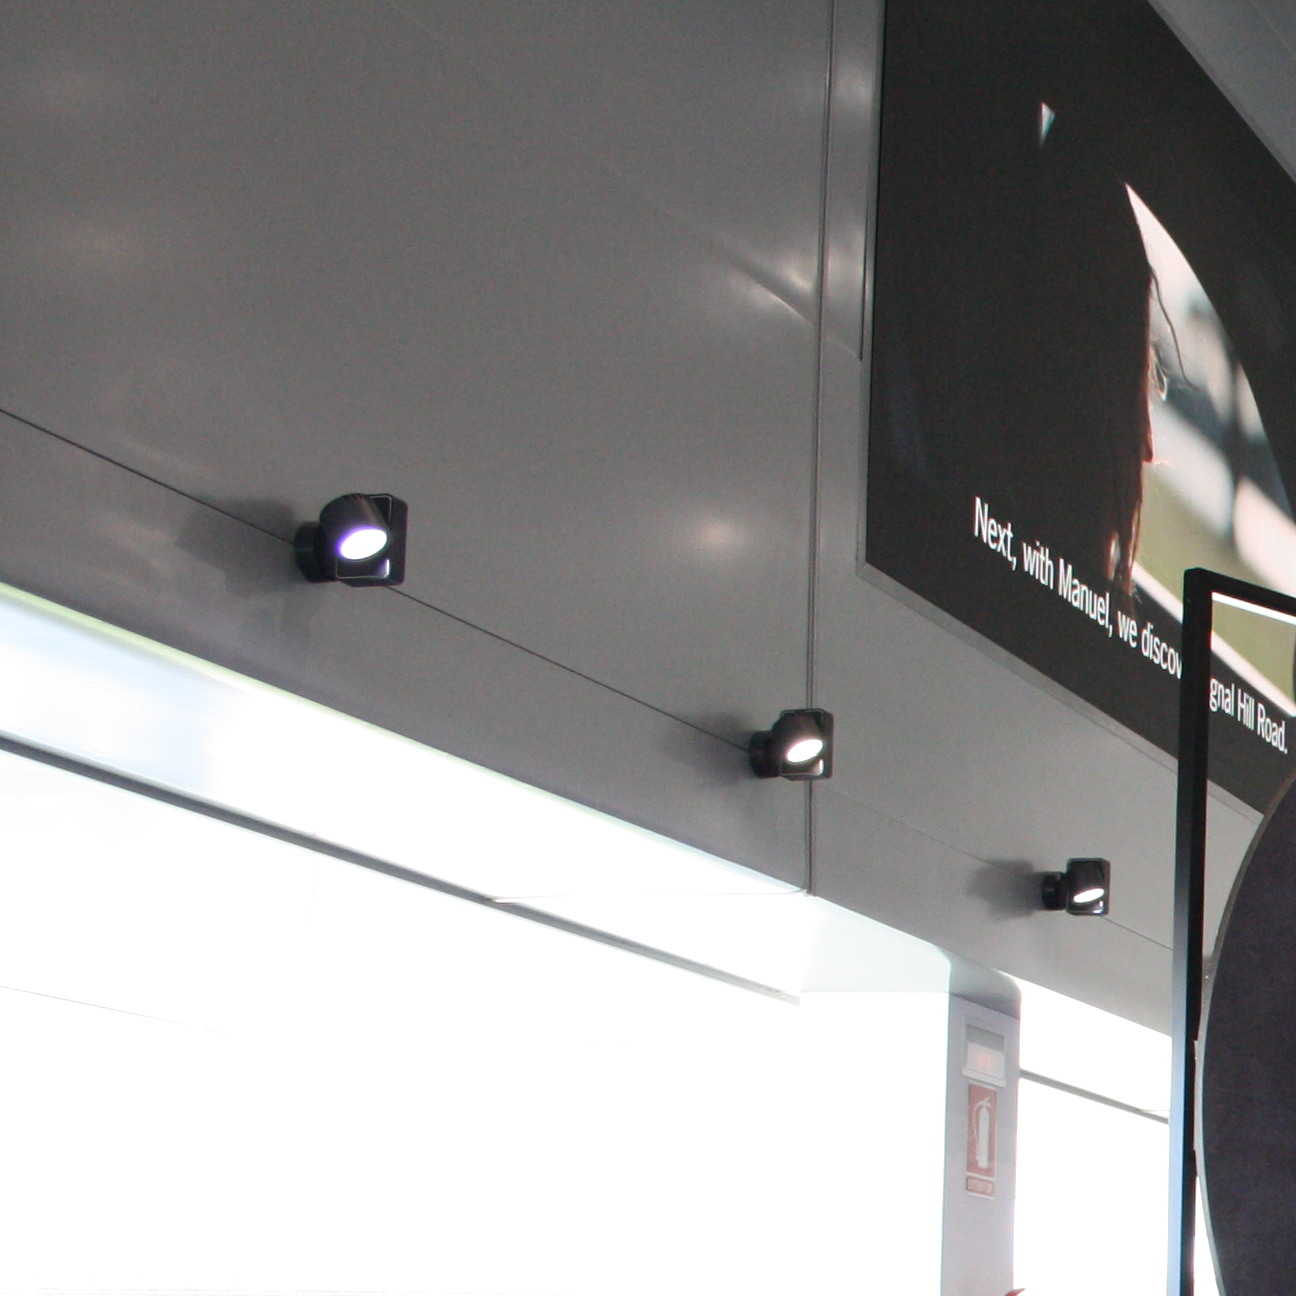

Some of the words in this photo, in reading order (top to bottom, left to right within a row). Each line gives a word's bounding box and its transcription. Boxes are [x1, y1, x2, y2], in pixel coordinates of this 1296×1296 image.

[974, 496, 1017, 571] Next,
[1022, 541, 1054, 590] with
[1059, 558, 1112, 638] Manuel,
[1118, 610, 1138, 648] we
[1141, 622, 1182, 679] discov
[1209, 678, 1234, 717] gnal
[1237, 688, 1255, 730] Hill
[1257, 702, 1288, 754] Road.
